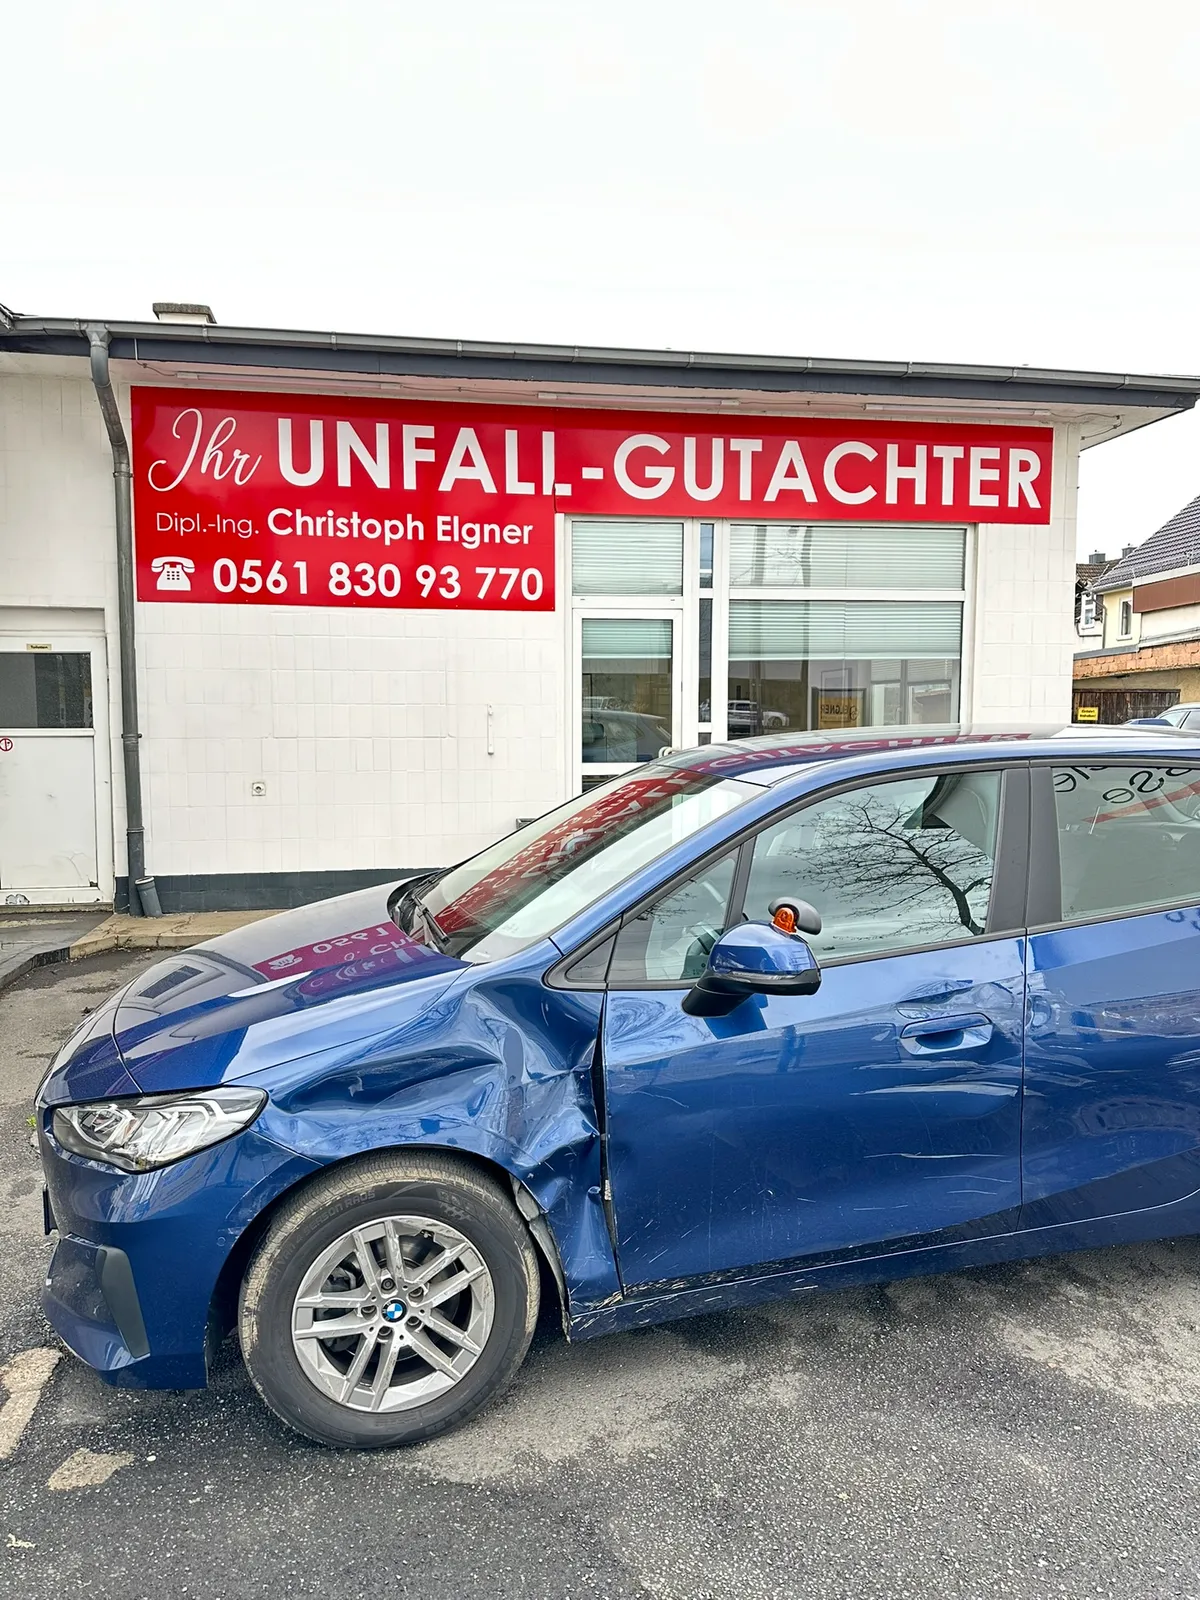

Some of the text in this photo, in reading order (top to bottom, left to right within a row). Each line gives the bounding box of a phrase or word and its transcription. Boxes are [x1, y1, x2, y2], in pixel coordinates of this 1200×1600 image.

[147, 408, 262, 493] Ihr
[155, 508, 534, 549] Dipl.-Ing. Christoph Elgner
[212, 558, 543, 601] 0561 830 93 770
